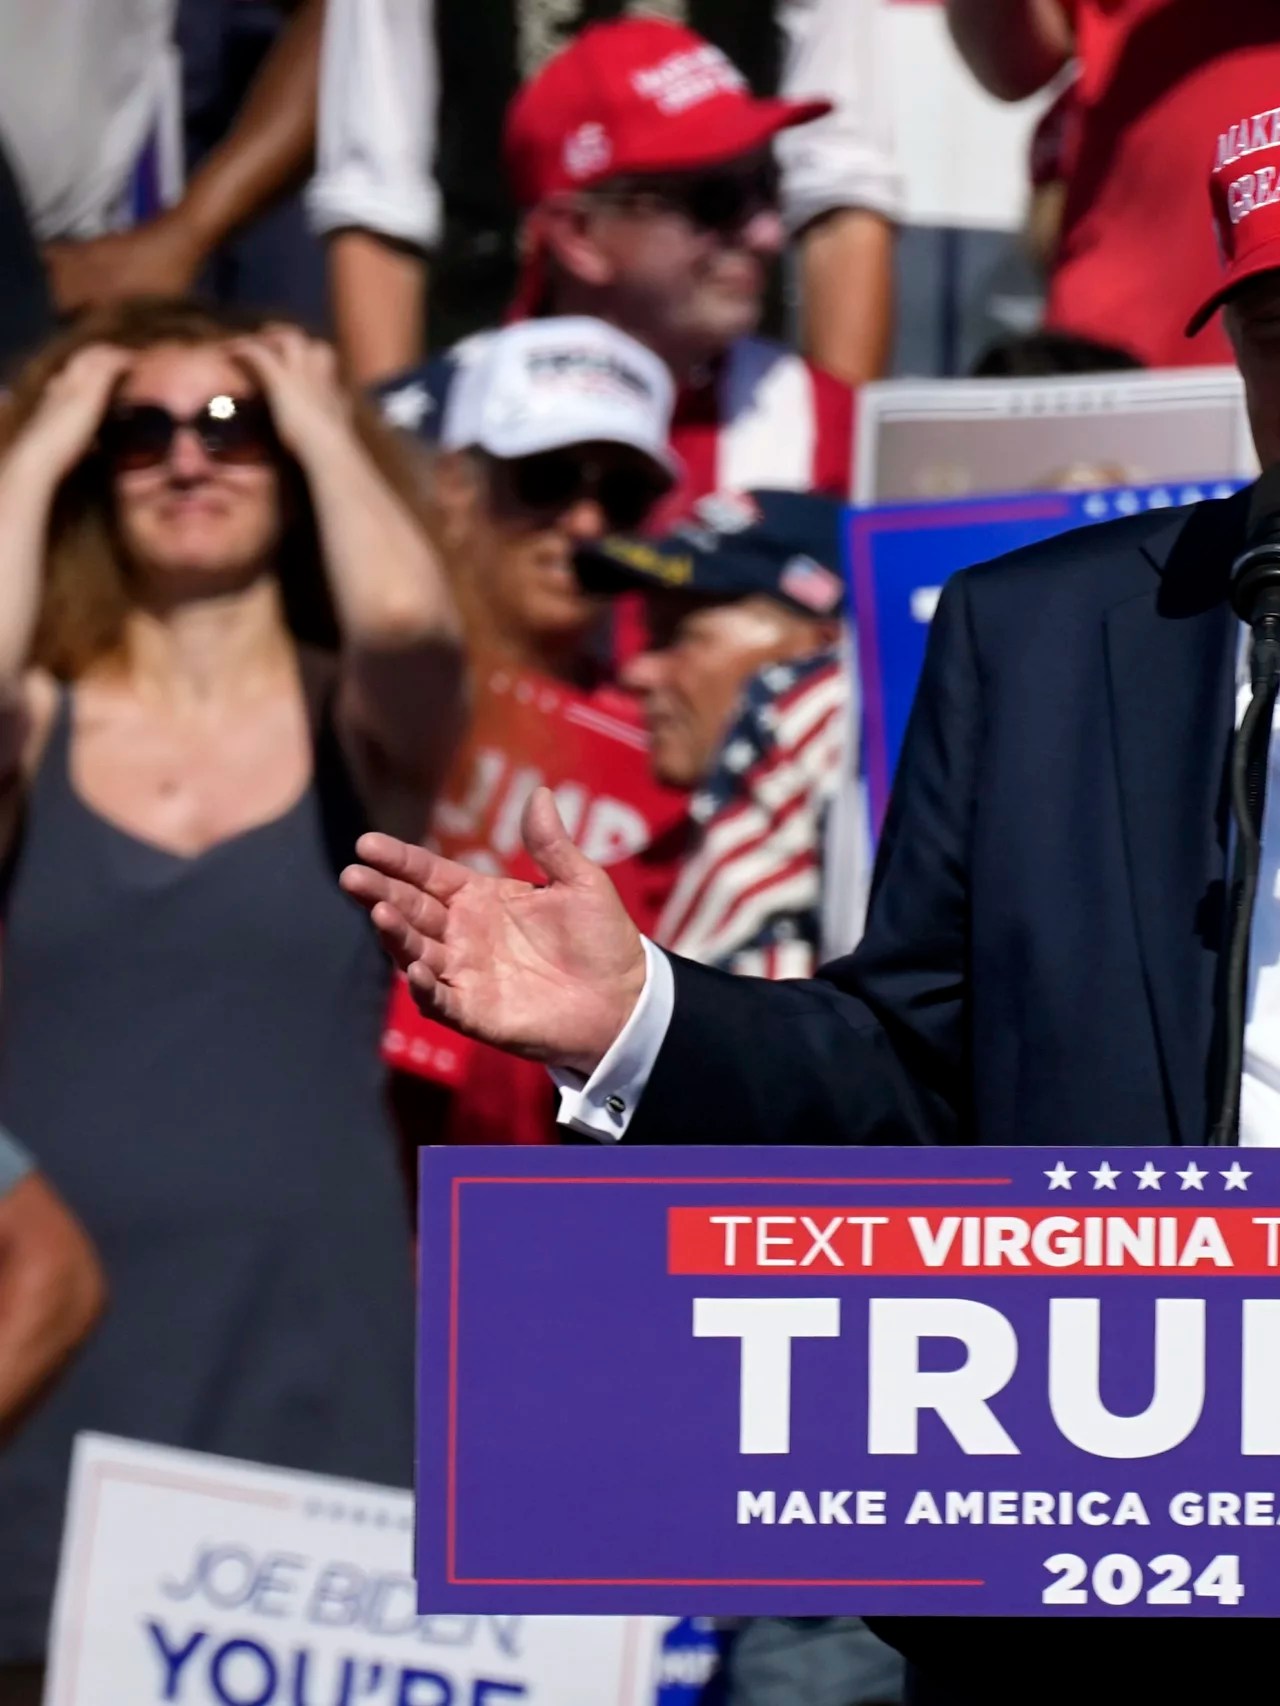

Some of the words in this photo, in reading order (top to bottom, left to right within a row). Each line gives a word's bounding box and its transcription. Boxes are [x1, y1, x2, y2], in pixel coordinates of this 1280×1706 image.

[710, 1216, 889, 1267] TEXT
[908, 1215, 1234, 1268] VIRGINIA
[737, 1490, 887, 1525] MAKE
[905, 1491, 1151, 1526] AMERICA
[155, 1540, 309, 1620] JOE
[1042, 1553, 1245, 1606] 2024
